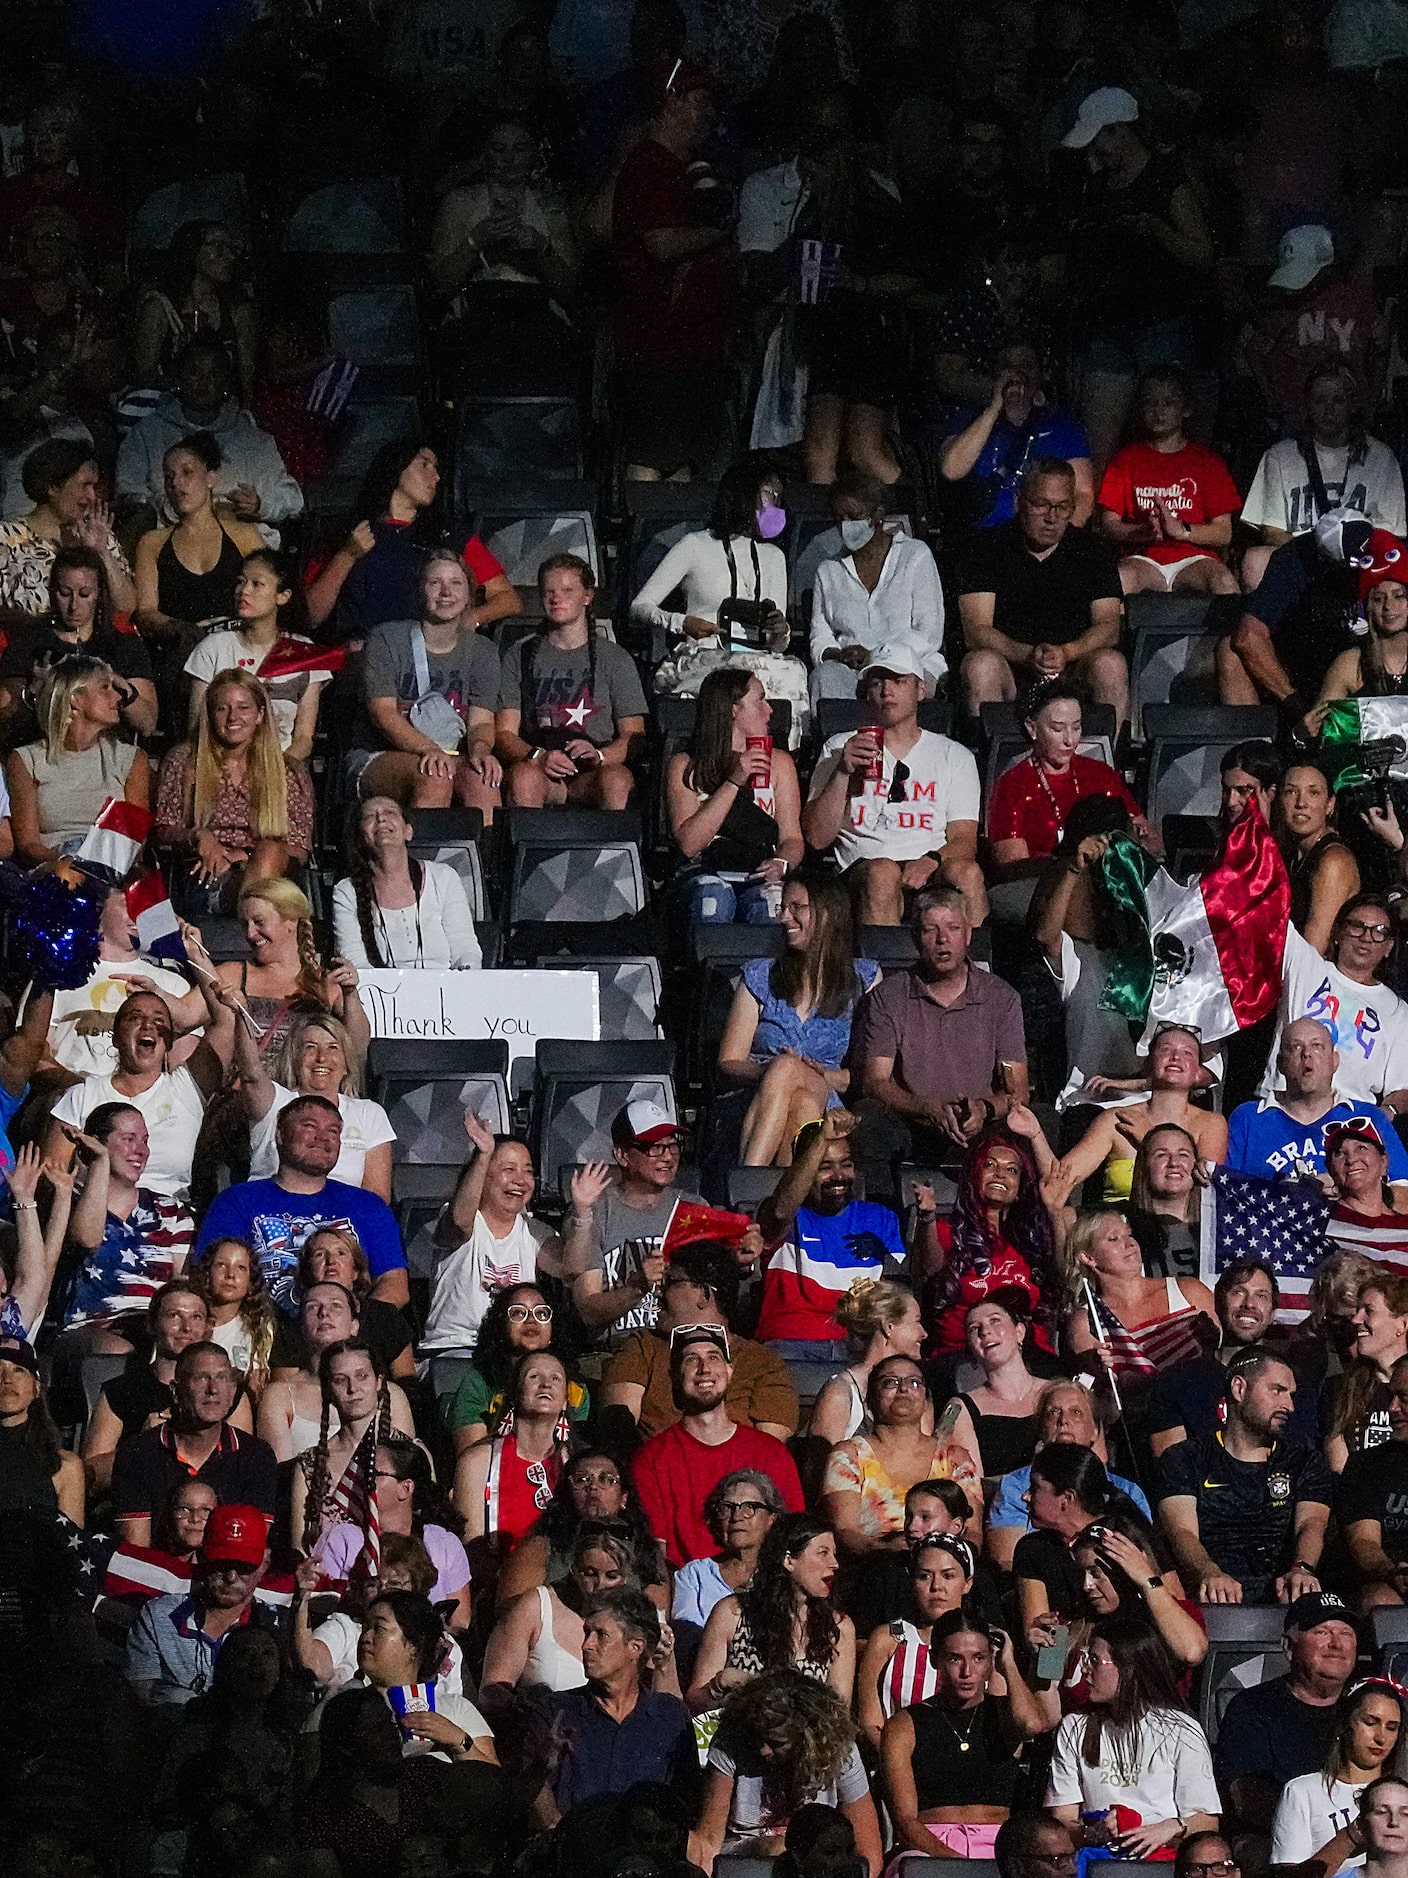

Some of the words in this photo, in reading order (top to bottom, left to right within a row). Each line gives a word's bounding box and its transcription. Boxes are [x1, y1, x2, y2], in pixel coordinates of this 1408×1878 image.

[1297, 310, 1357, 352] NY
[361, 983, 456, 1040] Thank
[484, 1017, 536, 1040] you
[1385, 1493, 1408, 1516] U
[1320, 1597, 1346, 1608] USA
